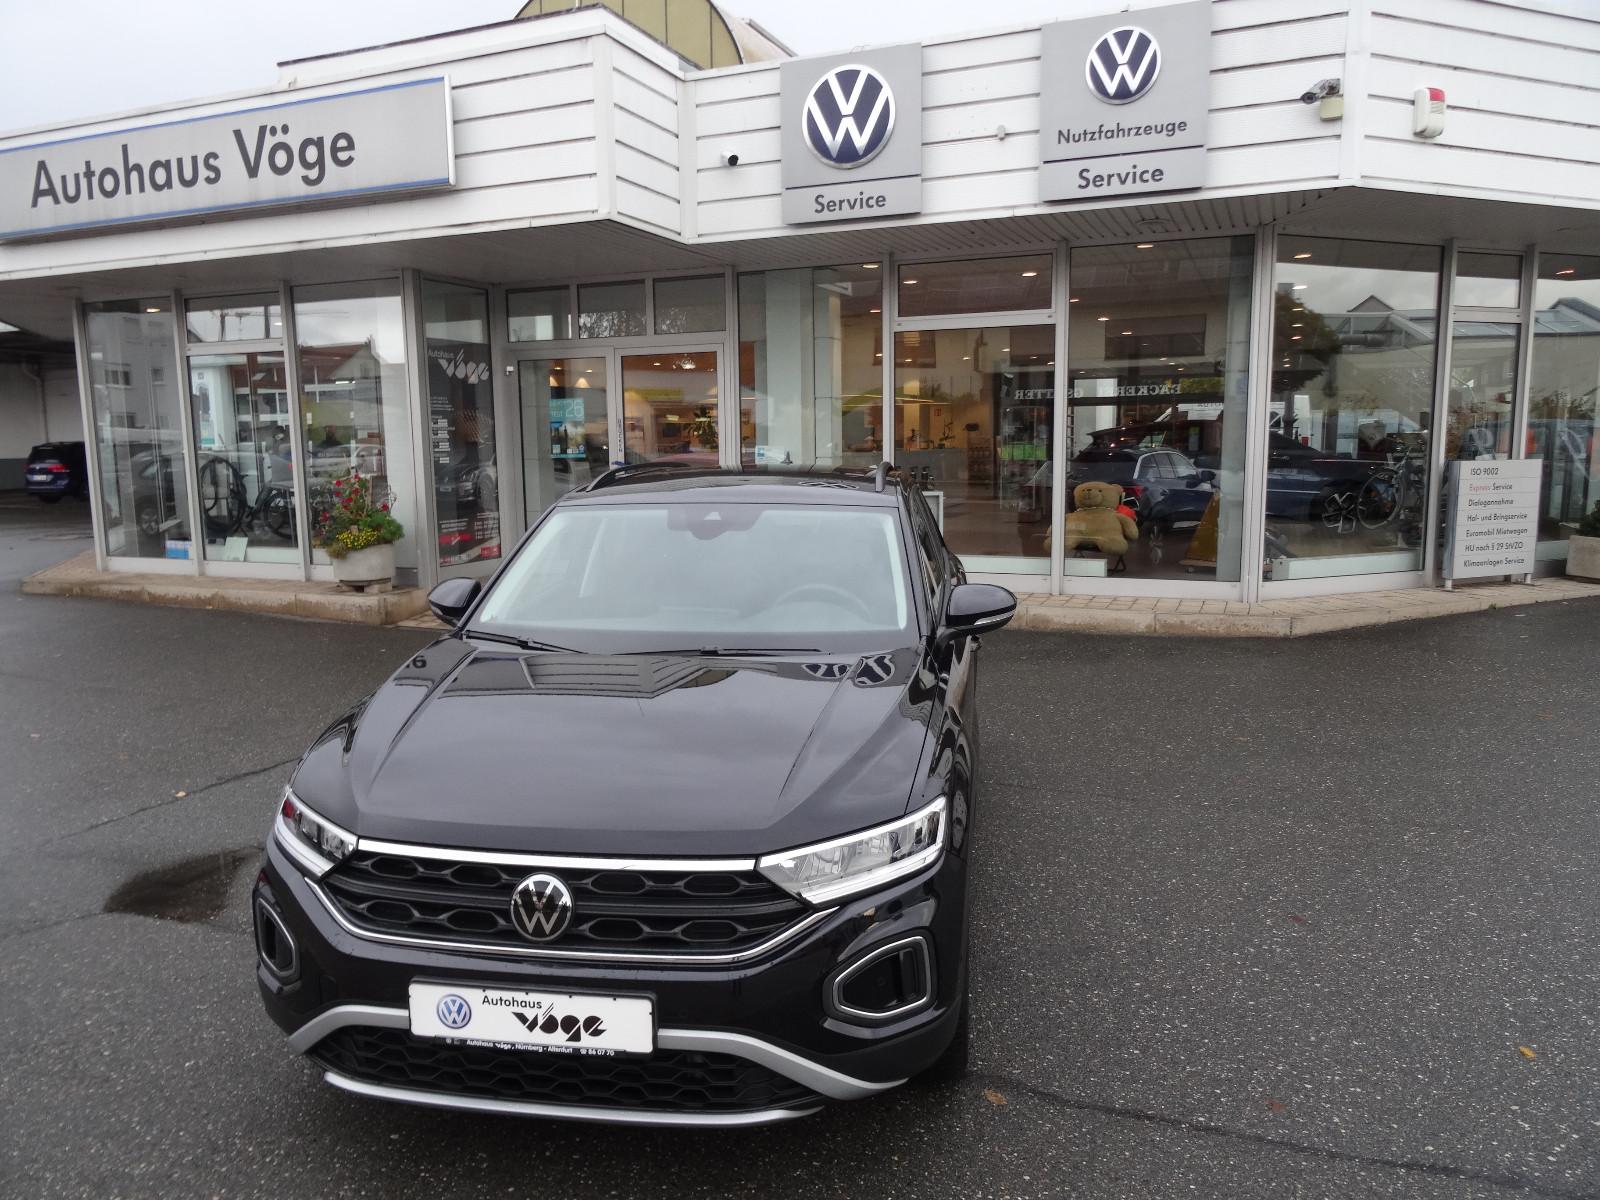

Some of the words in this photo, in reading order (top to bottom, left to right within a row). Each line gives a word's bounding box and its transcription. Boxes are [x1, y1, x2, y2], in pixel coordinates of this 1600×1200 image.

[1057, 118, 1188, 146] Nutzfahrzeuge
[31, 144, 221, 208] Autohaus
[233, 123, 356, 187] Vöge
[1077, 165, 1165, 190] Service
[814, 192, 887, 214] Service
[1470, 467, 1482, 476] ISO
[1483, 467, 1499, 476] 9002
[1469, 483, 1491, 492] Express
[1492, 482, 1513, 491] Service
[1468, 498, 1514, 508] Dialogannahme
[1493, 513, 1528, 522] Bringservice
[1466, 528, 1495, 537] Euromobil
[1496, 527, 1528, 536] Mietwagen
[1465, 544, 1475, 552] HU
[1475, 543, 1490, 551] nach
[1496, 542, 1504, 551] 29
[1504, 541, 1524, 550] StVZO
[1463, 558, 1504, 568] Klimaanlagen
[1504, 557, 1525, 565] Service
[482, 995, 543, 1010] Autohaus
[466, 1039, 493, 1047] Autohaus
